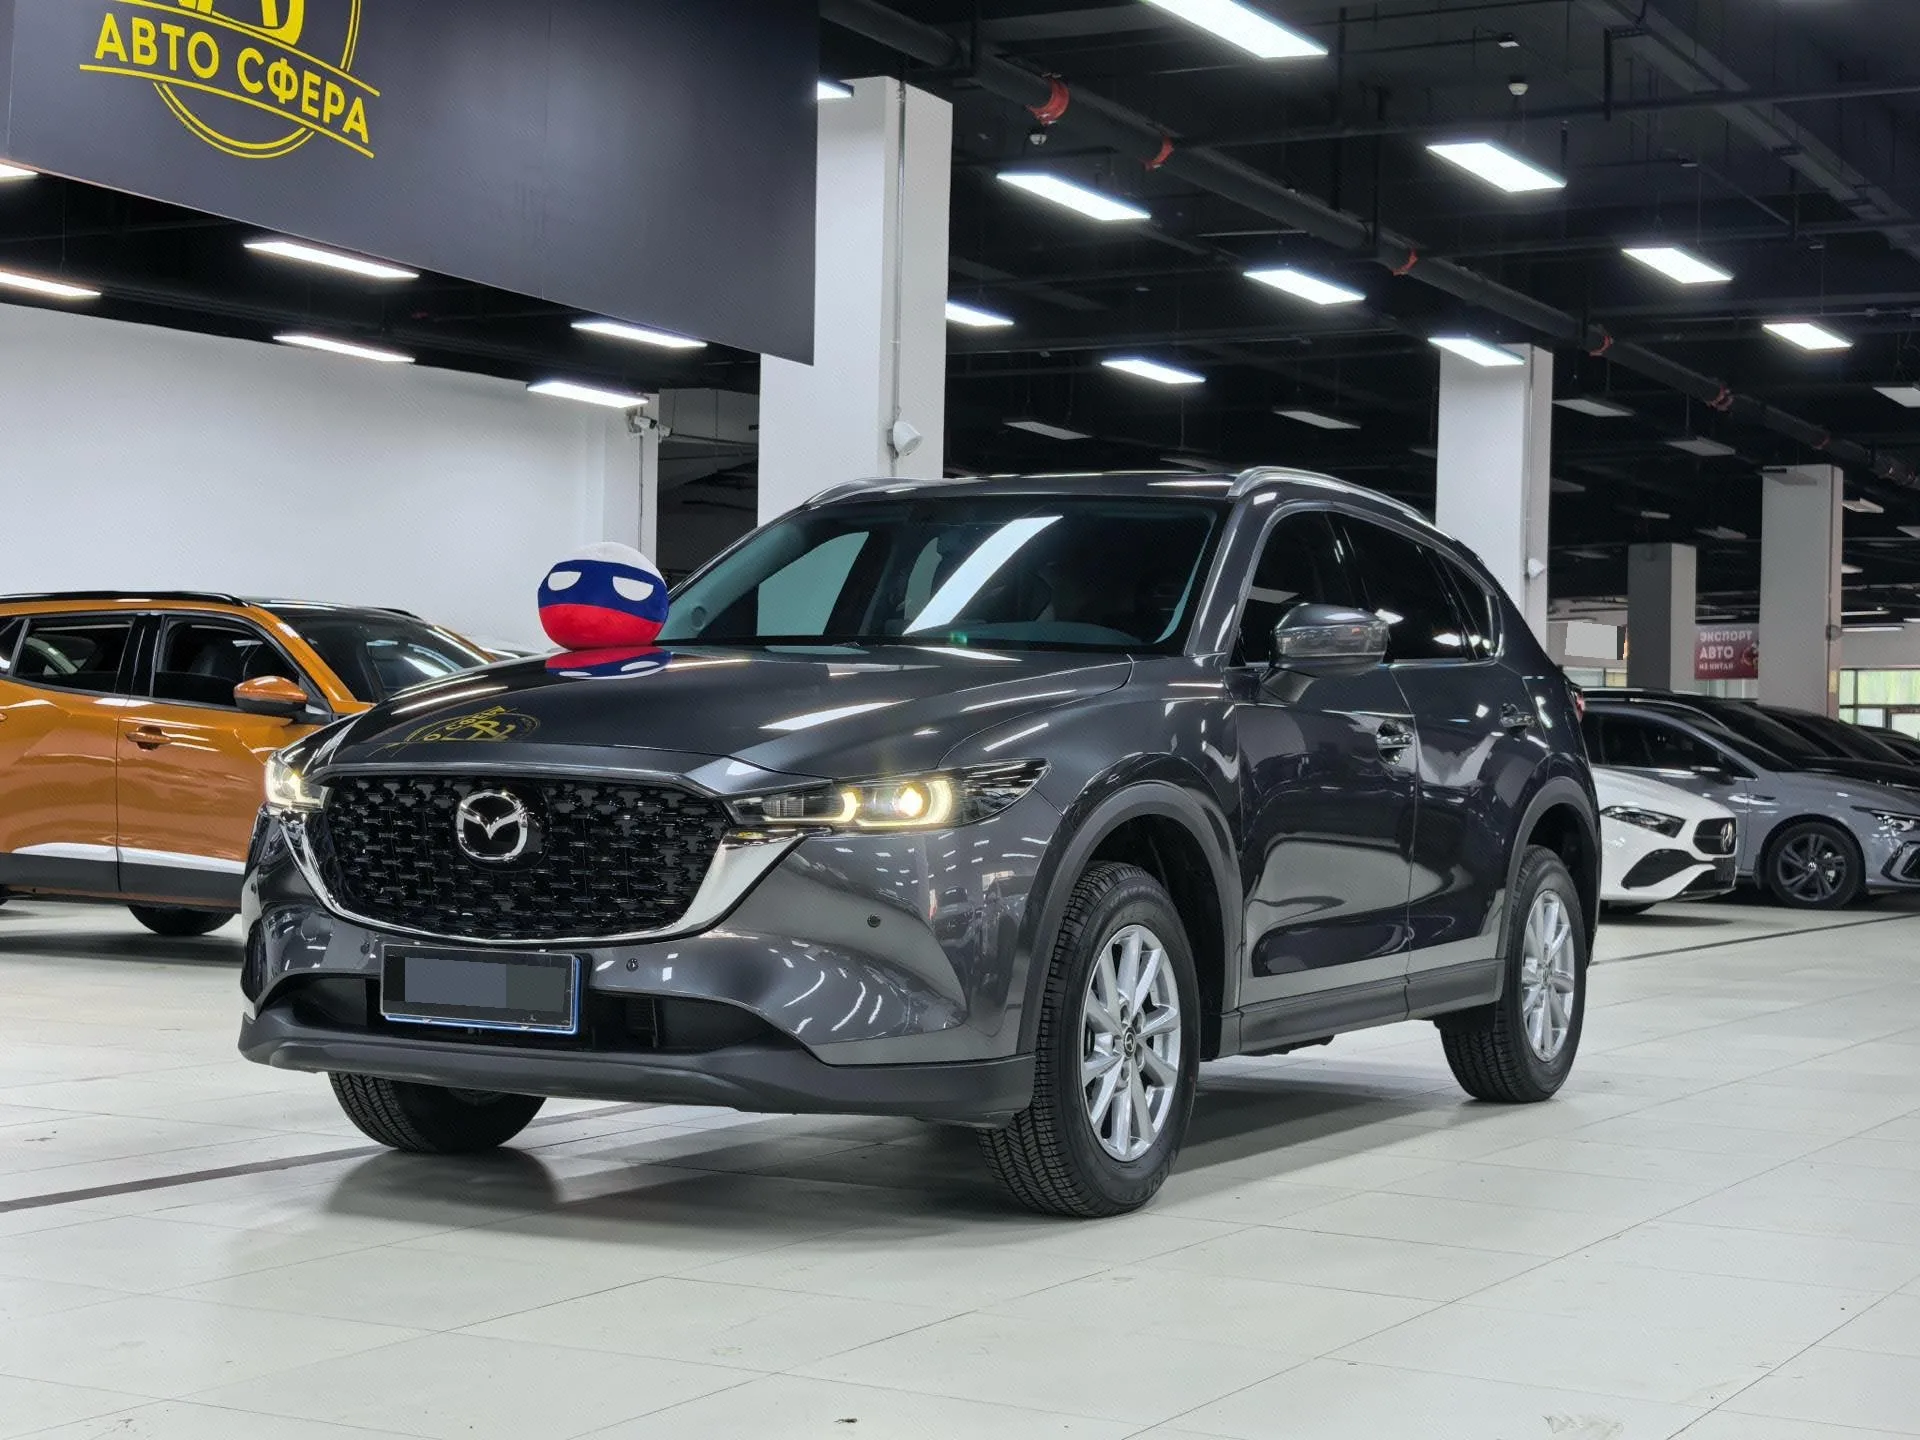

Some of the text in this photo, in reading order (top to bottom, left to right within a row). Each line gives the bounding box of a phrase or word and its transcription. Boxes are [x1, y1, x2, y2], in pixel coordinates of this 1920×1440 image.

[95, 12, 219, 79] АВТО
[236, 47, 370, 144] СФЕРА
[1700, 630, 1752, 642] ЭКСПОРТ
[1699, 645, 1734, 660] АВТО
